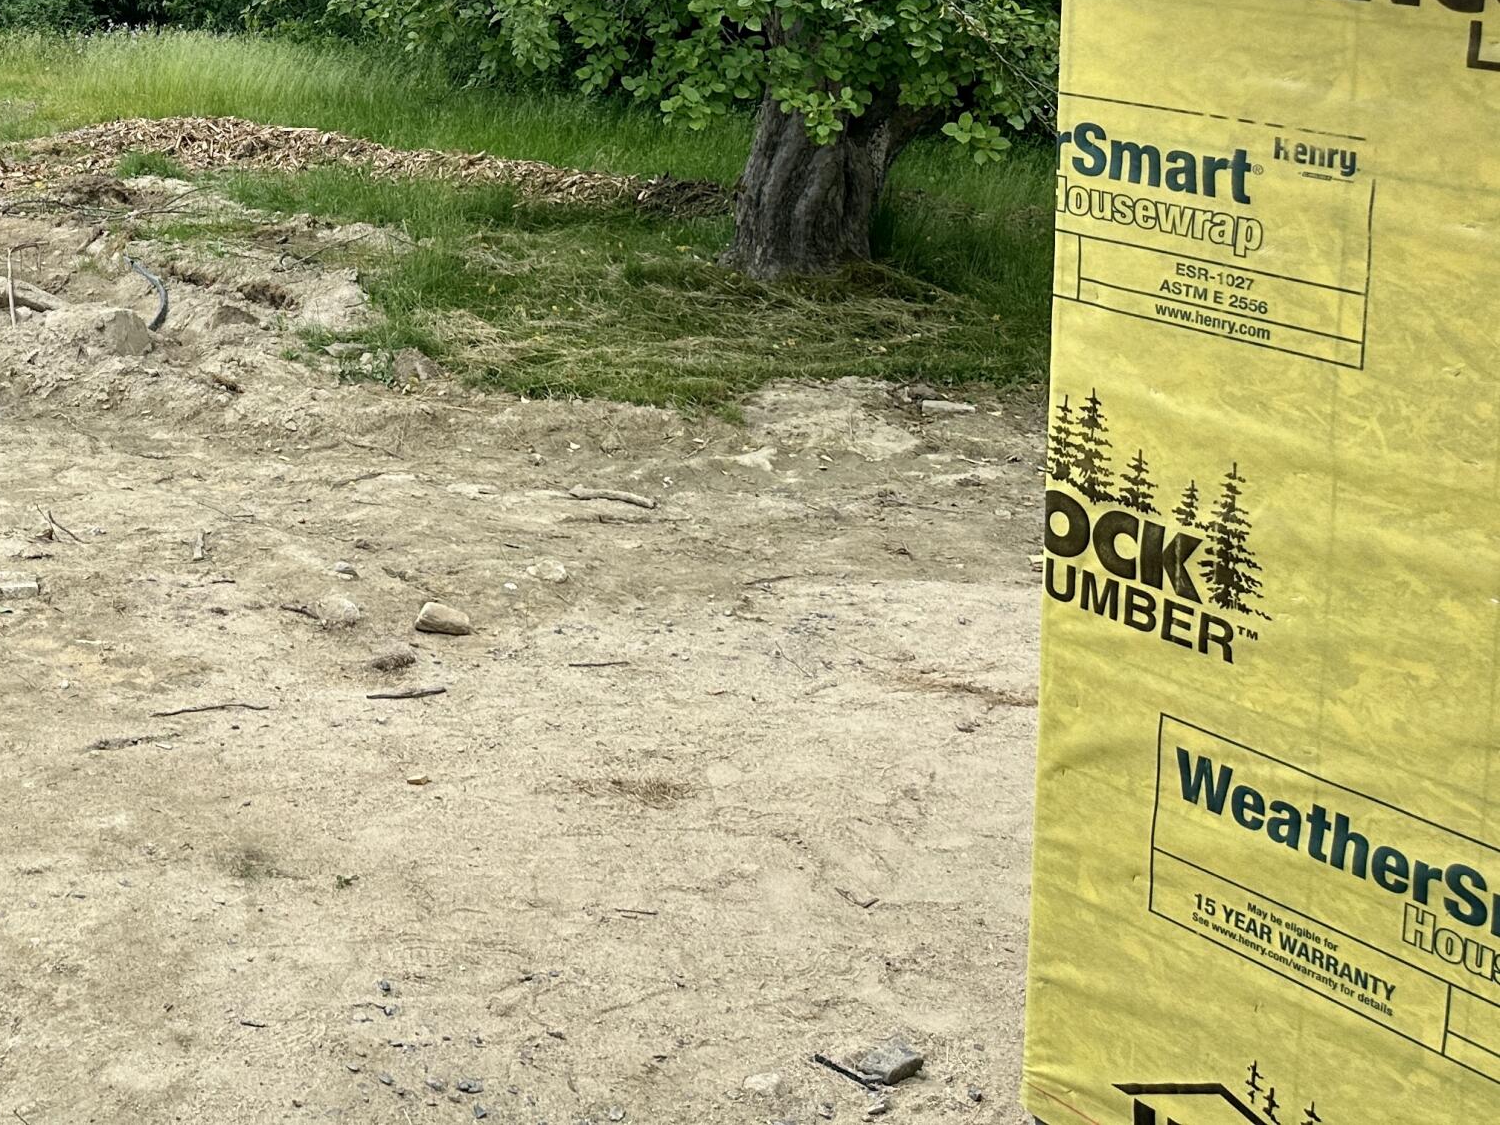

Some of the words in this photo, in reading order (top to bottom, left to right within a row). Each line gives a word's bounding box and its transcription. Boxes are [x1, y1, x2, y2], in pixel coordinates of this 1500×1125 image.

[1159, 279, 1208, 302] ASTM
[1212, 290, 1224, 305] E
[1228, 294, 1269, 315] 2556
[1175, 262, 1255, 291] ESR-1027
[1155, 303, 1271, 341] www.henry.com
[1176, 746, 1500, 938] WeatherS
[1194, 892, 1216, 917] 15
[1221, 904, 1273, 945] YEAR
[1279, 930, 1396, 1002] WARRANTY
[1247, 902, 1268, 921] May
[1270, 912, 1283, 927] be
[1285, 920, 1321, 945] eligible
[1324, 937, 1339, 952] for
[1192, 912, 1210, 928] See
[1211, 922, 1339, 992] www.henry.com/warranty
[1340, 982, 1355, 999] for
[1357, 992, 1394, 1018] details
